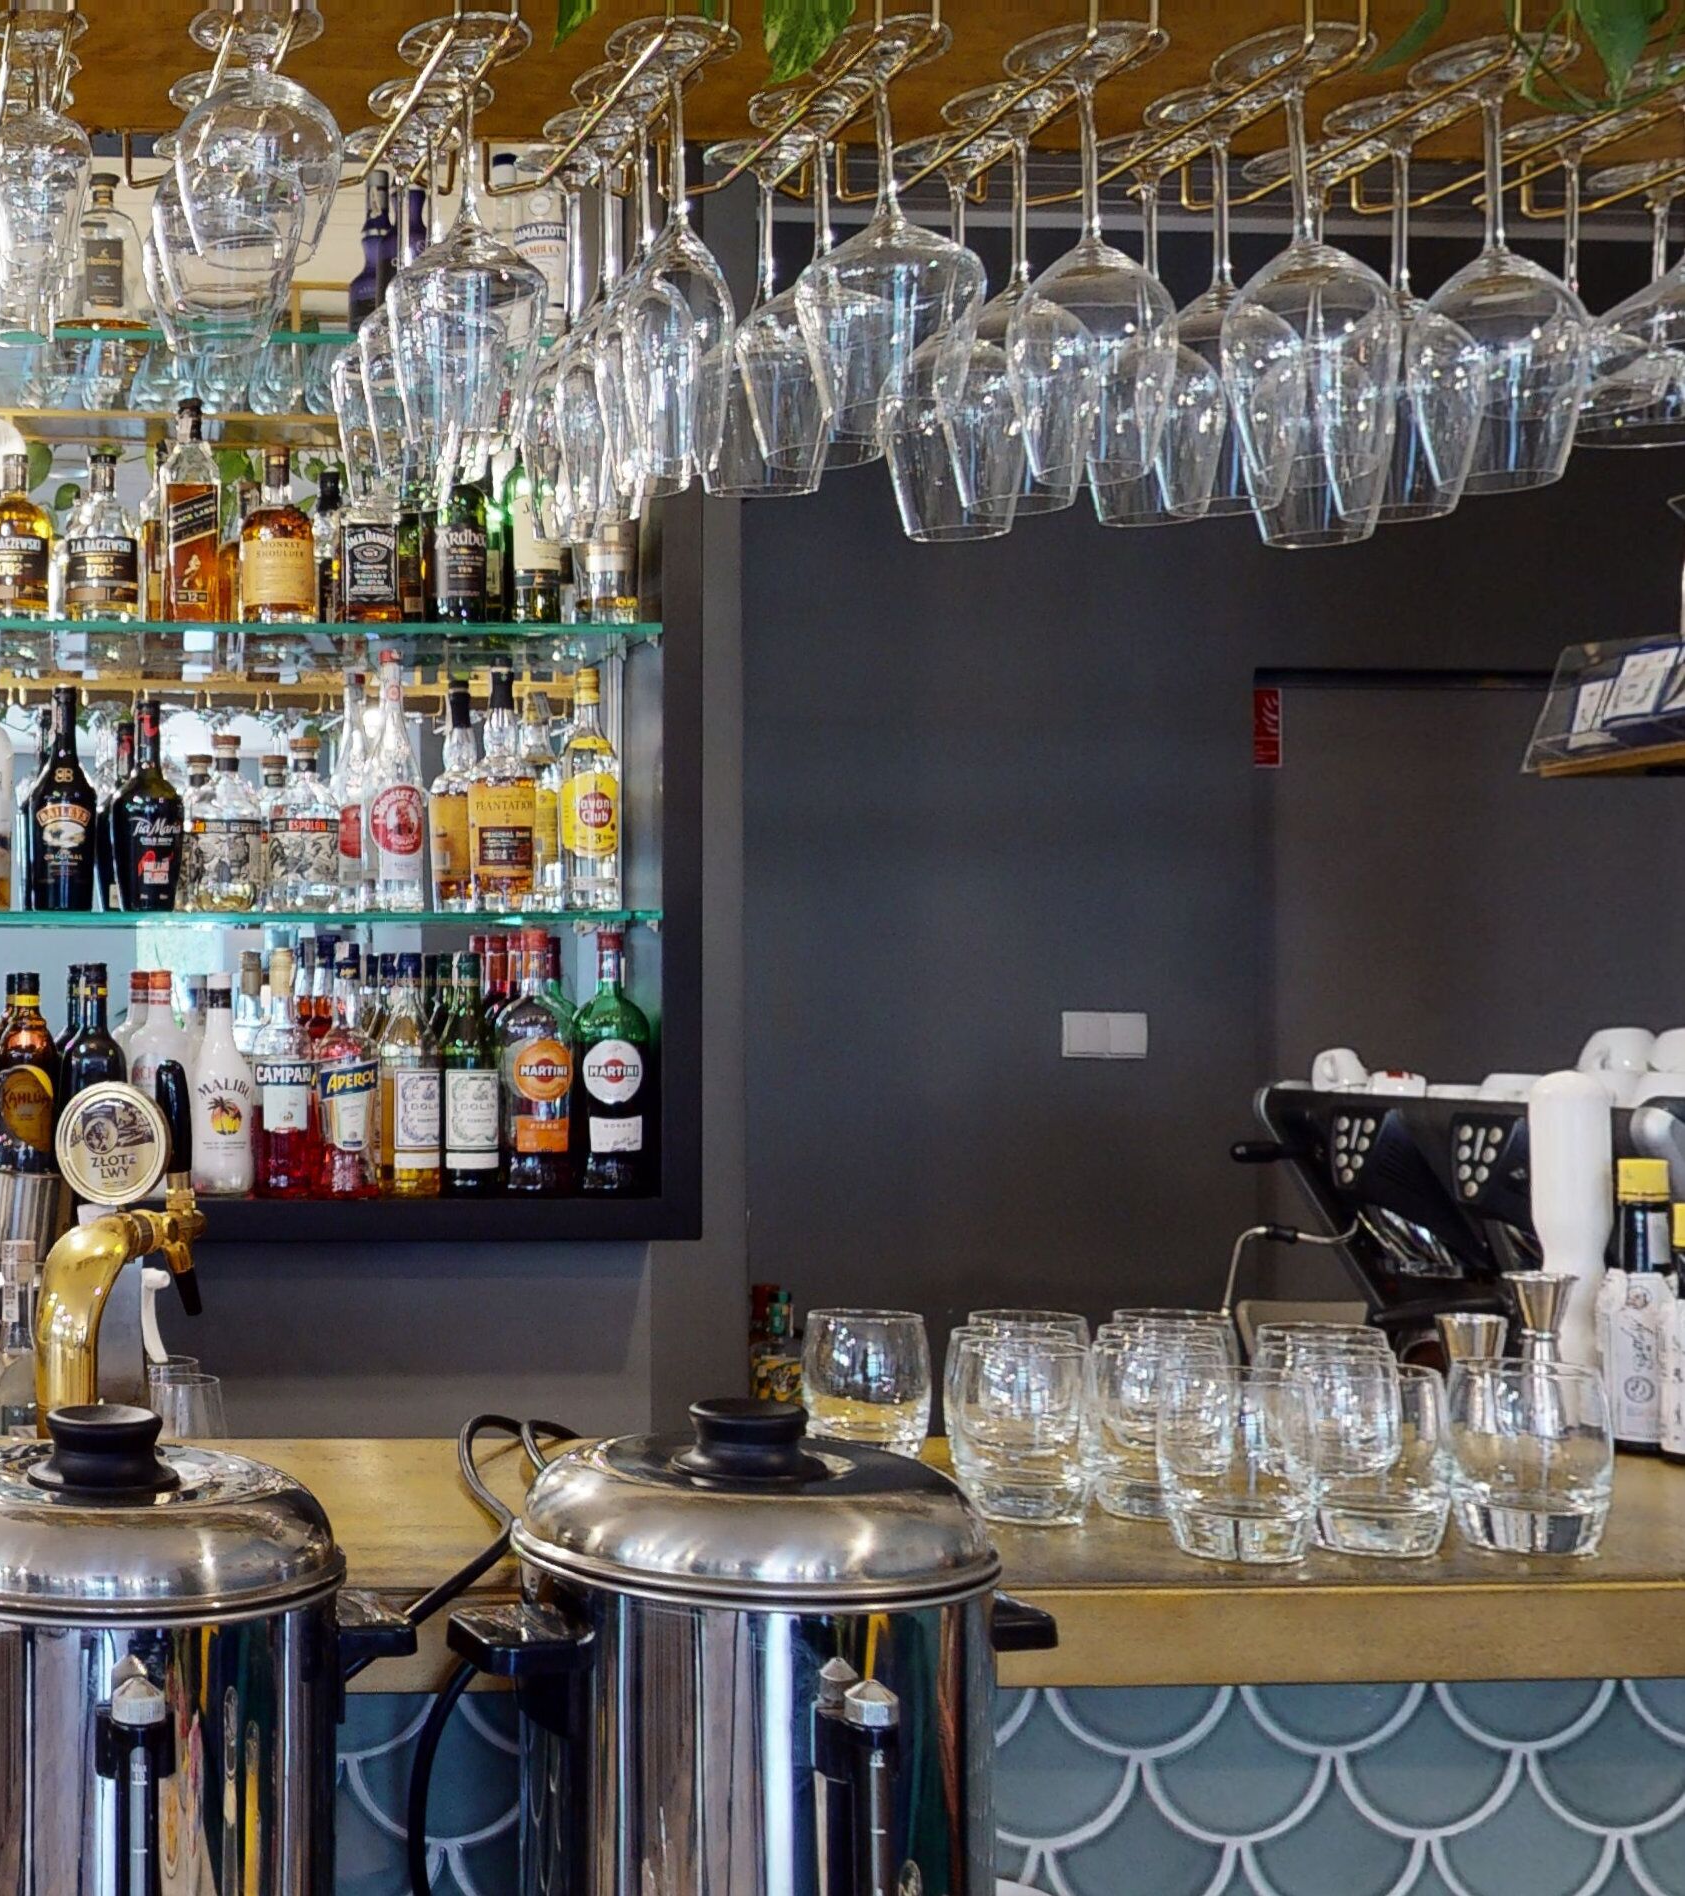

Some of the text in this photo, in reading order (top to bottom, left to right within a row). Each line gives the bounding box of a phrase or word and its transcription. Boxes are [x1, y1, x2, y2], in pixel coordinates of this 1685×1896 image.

[84, 540, 132, 553] BACZEWSKI
[256, 550, 304, 558] SHOULDER
[39, 805, 88, 824] BAILEYS
[581, 810, 610, 823] Club
[128, 816, 152, 836] Tia
[147, 817, 181, 837] Maria
[256, 1065, 311, 1083] CAMPARI
[520, 1065, 568, 1076] MARTINI
[589, 1065, 639, 1077] MARTINI
[327, 1069, 376, 1094] APEROL
[197, 1078, 250, 1100] MALIBU
[460, 1102, 495, 1110] DOLIN
[90, 1154, 137, 1168] ZŁOTE
[100, 1166, 130, 1179] LWY
